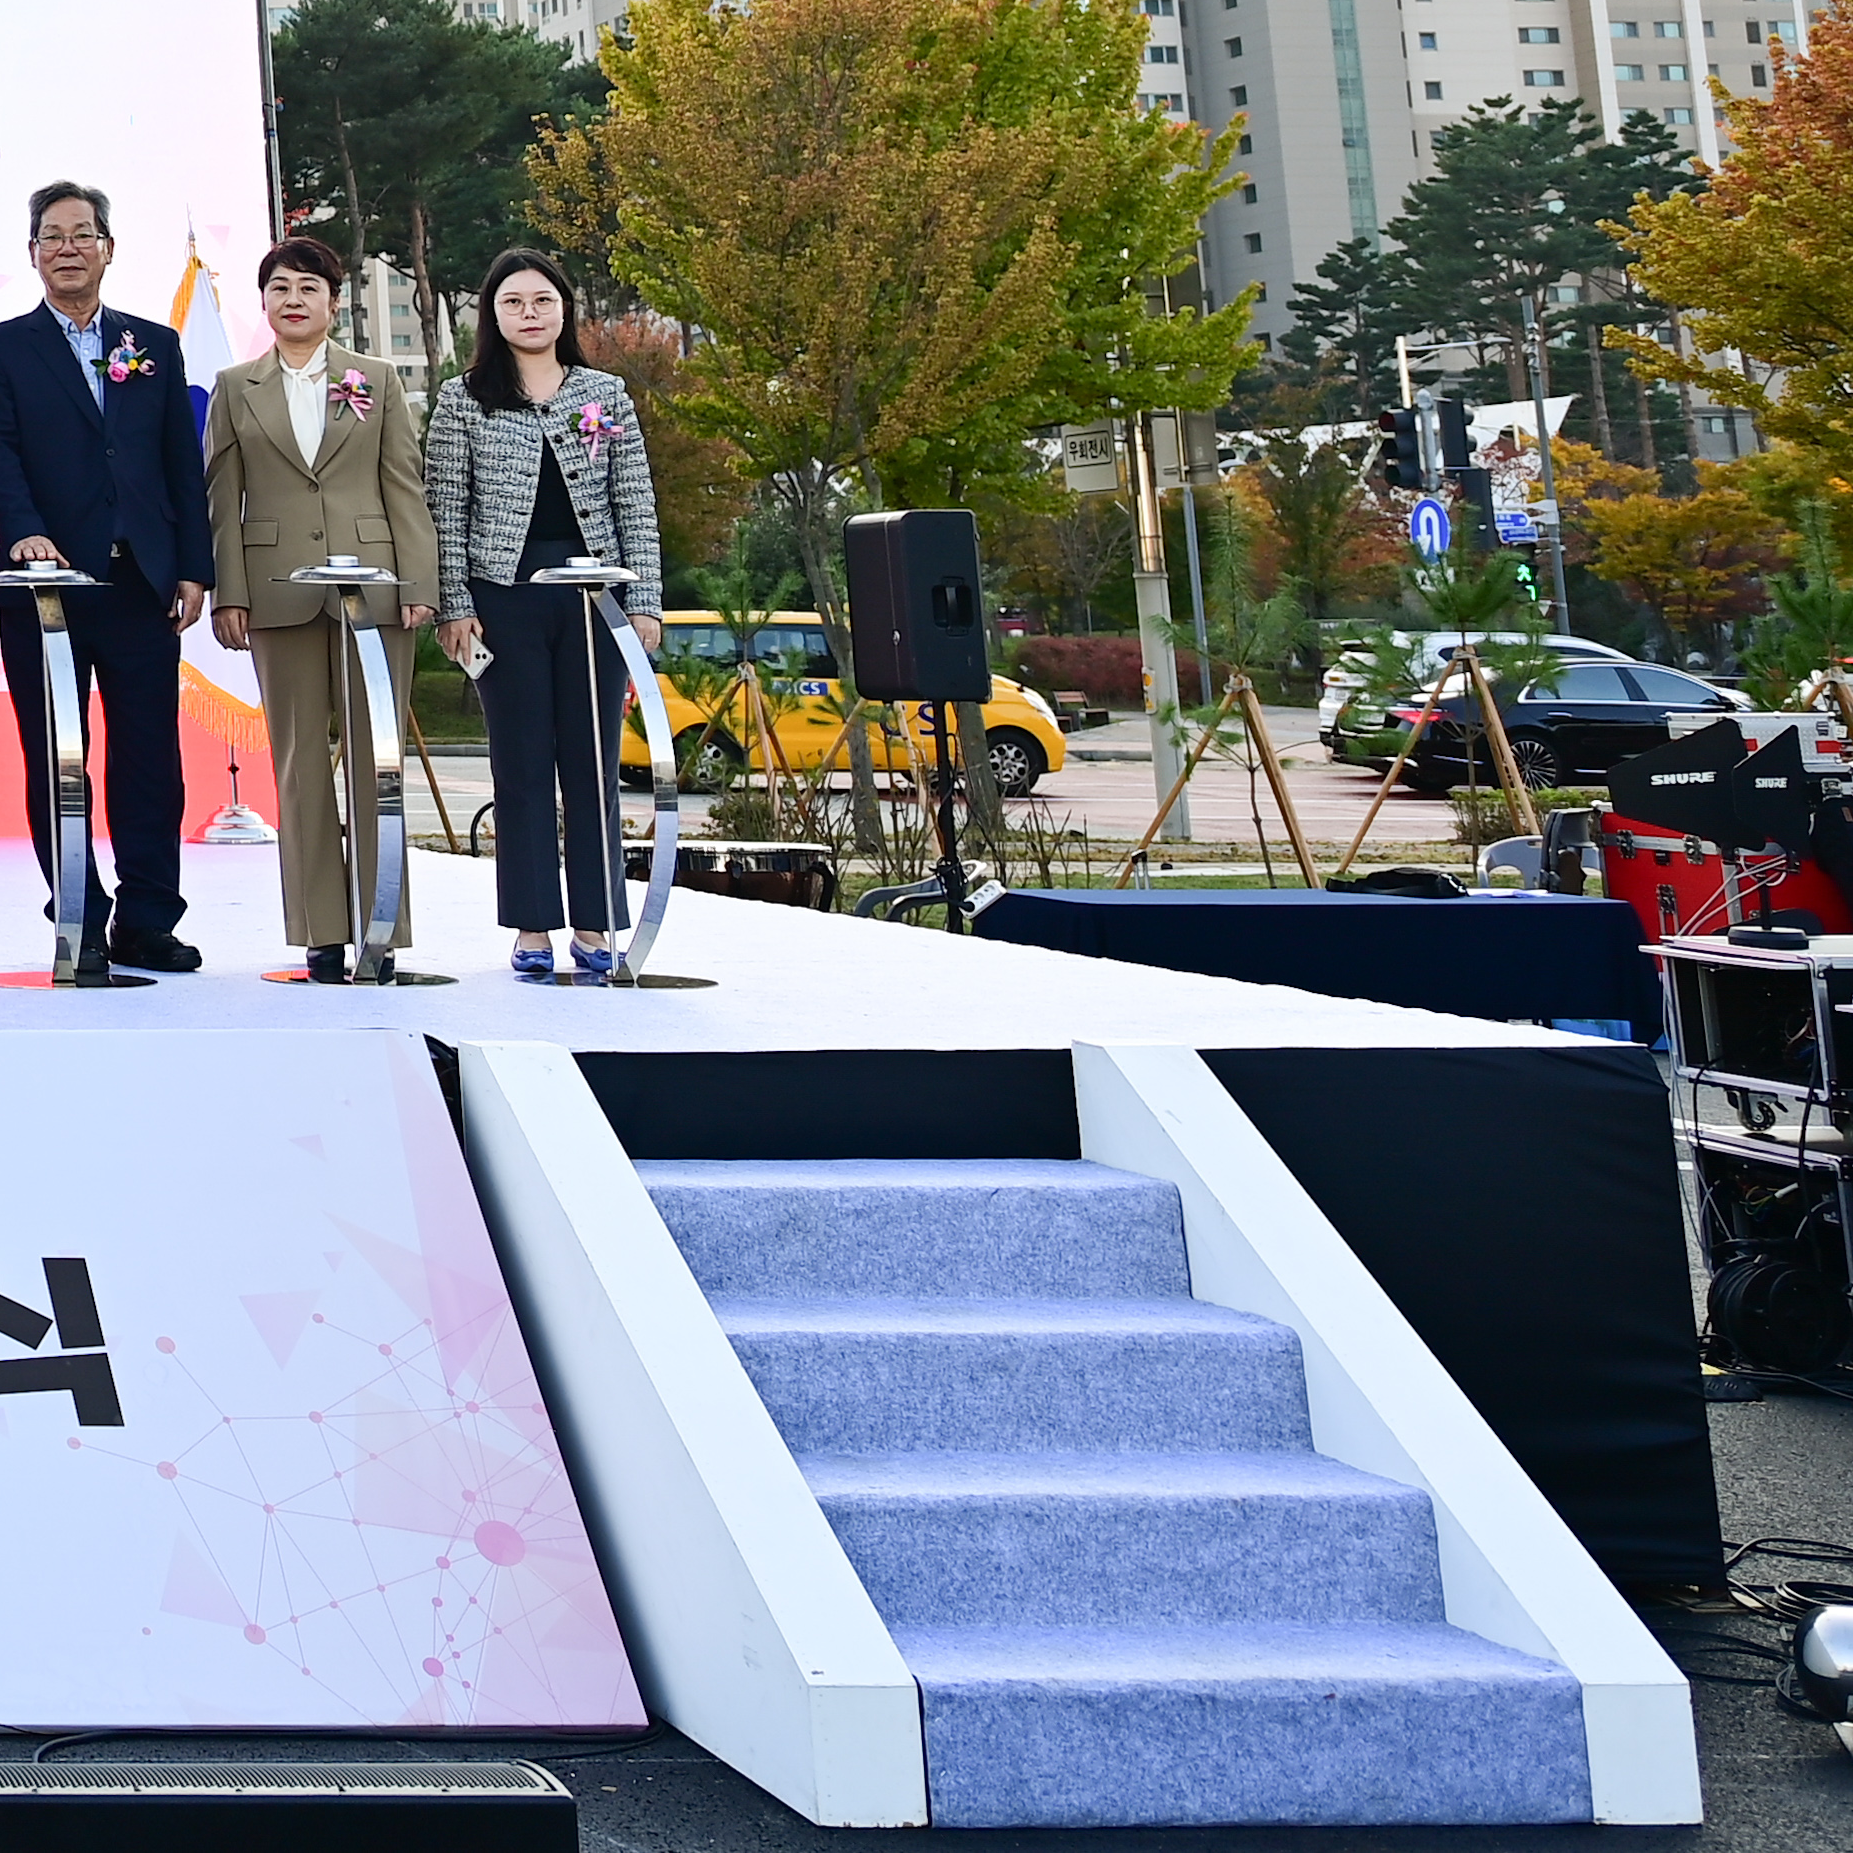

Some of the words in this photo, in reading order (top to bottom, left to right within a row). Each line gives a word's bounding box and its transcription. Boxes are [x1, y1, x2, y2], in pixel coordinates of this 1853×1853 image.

[1069, 437, 1109, 461] 우회전시
[1650, 771, 1717, 786] SHURE
[1755, 777, 1788, 789] SHURE
